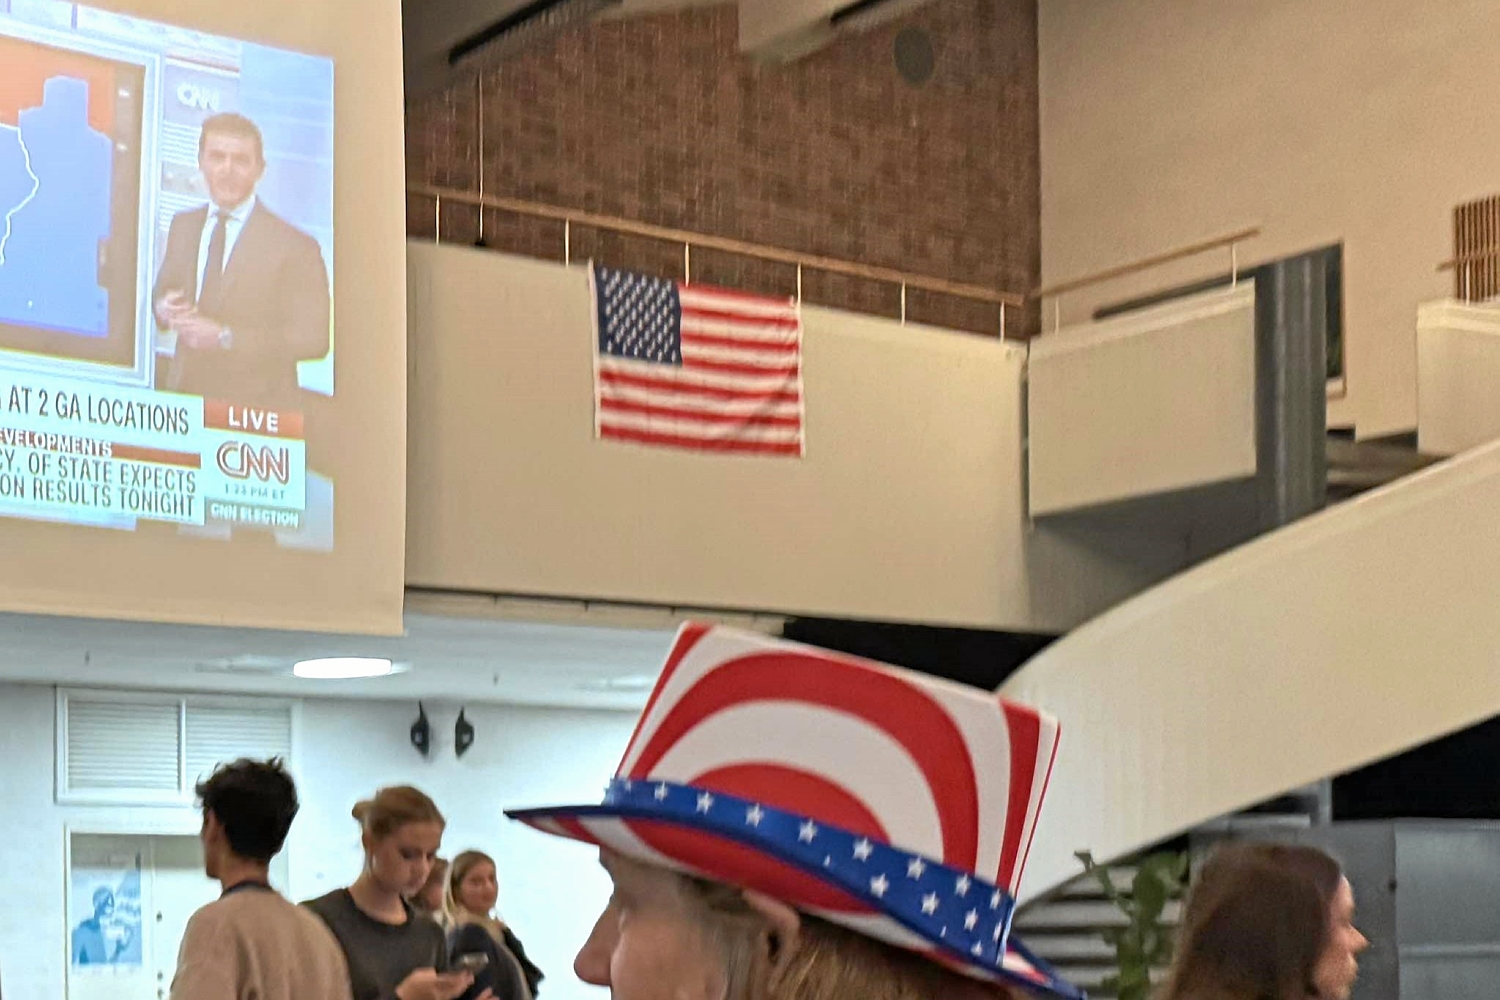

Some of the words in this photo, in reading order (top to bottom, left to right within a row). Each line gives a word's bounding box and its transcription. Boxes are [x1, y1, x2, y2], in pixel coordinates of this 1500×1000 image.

[8, 384, 32, 414] AT
[38, 388, 49, 417] 2
[55, 390, 81, 421] GA
[88, 394, 189, 436] LOCATIONS
[228, 405, 279, 433] LIVE
[28, 451, 51, 476] OF
[58, 455, 113, 484] STATE
[120, 463, 196, 494] EXPECTS
[216, 440, 289, 485] CNN
[33, 476, 111, 508] RESULTS
[119, 487, 195, 517] TONIGHT
